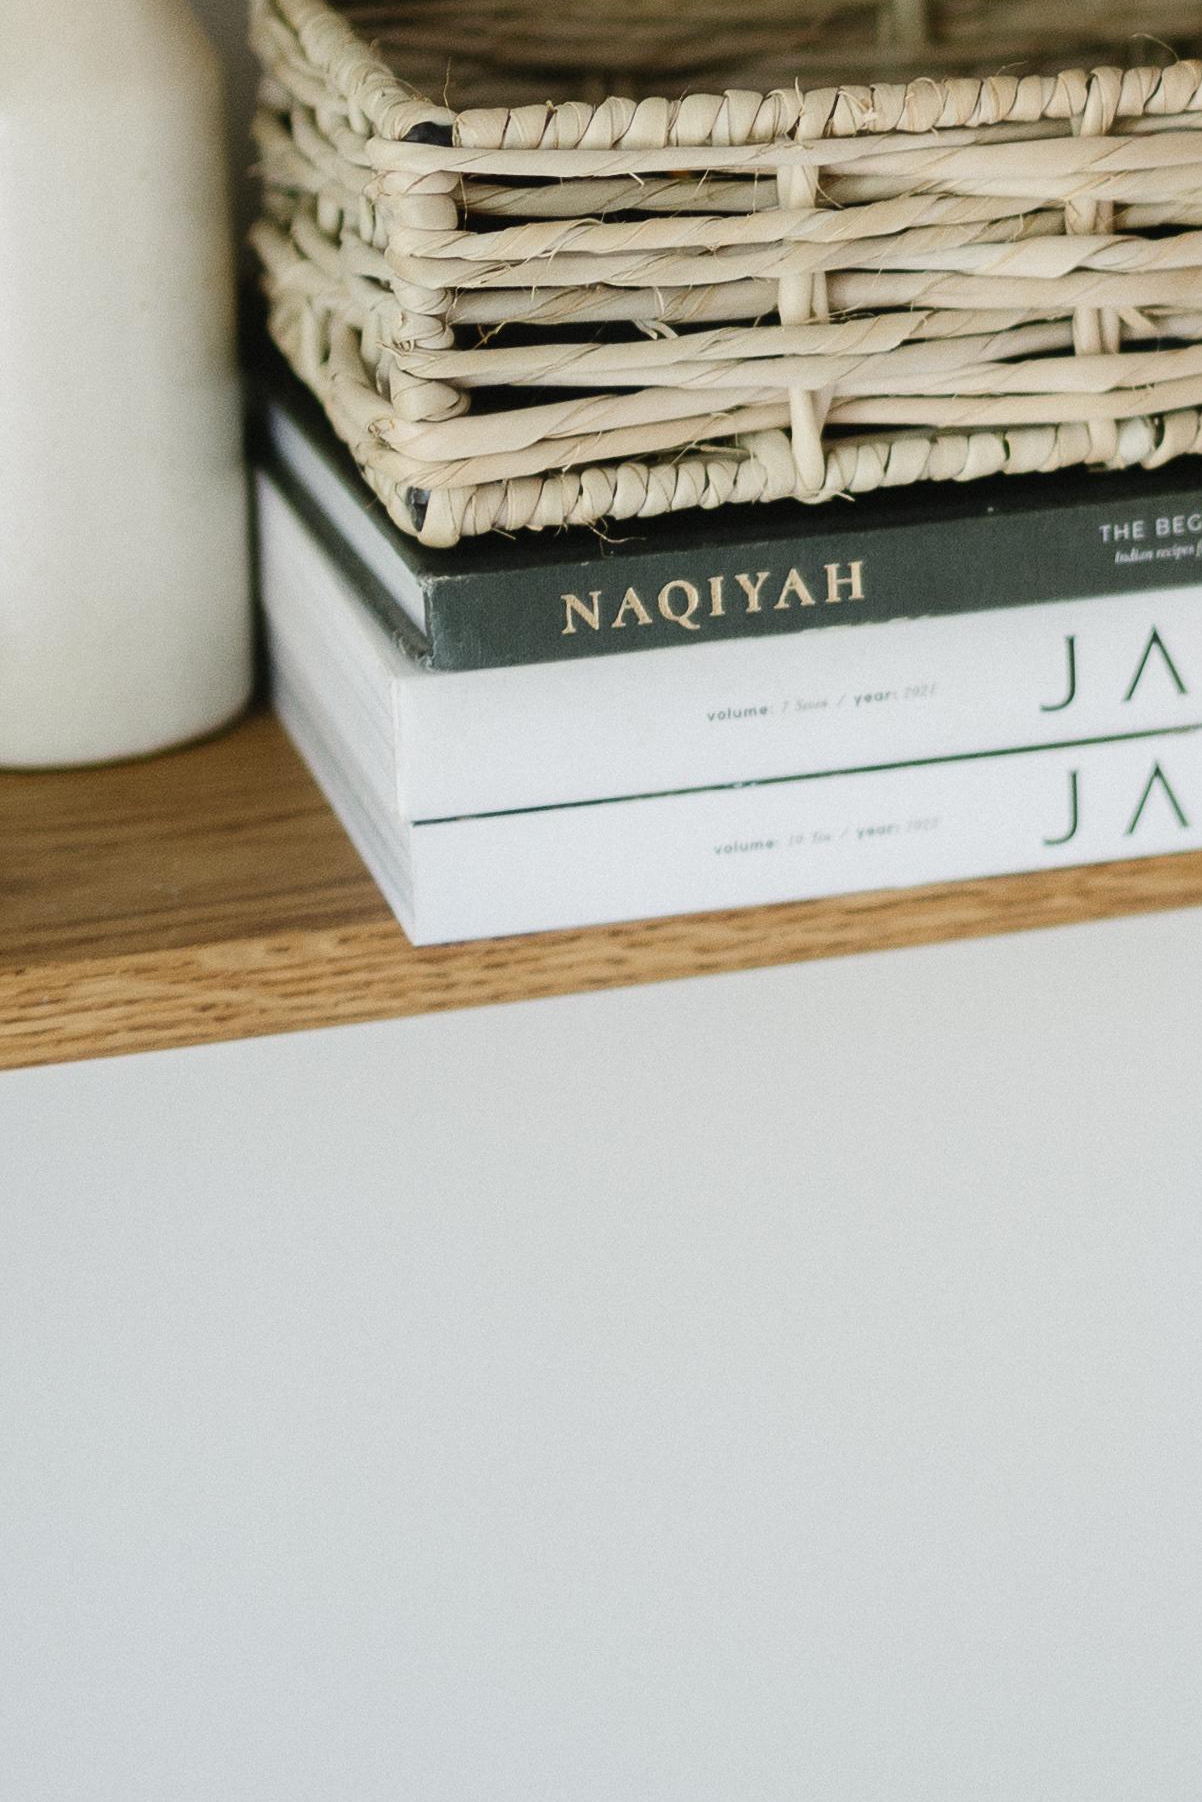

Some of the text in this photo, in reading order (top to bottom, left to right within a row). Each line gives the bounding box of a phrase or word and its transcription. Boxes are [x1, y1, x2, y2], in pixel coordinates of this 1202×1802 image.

[1099, 519, 1145, 543] THE
[1114, 547, 1153, 564] Indian
[560, 560, 865, 635] NAQIYAH
